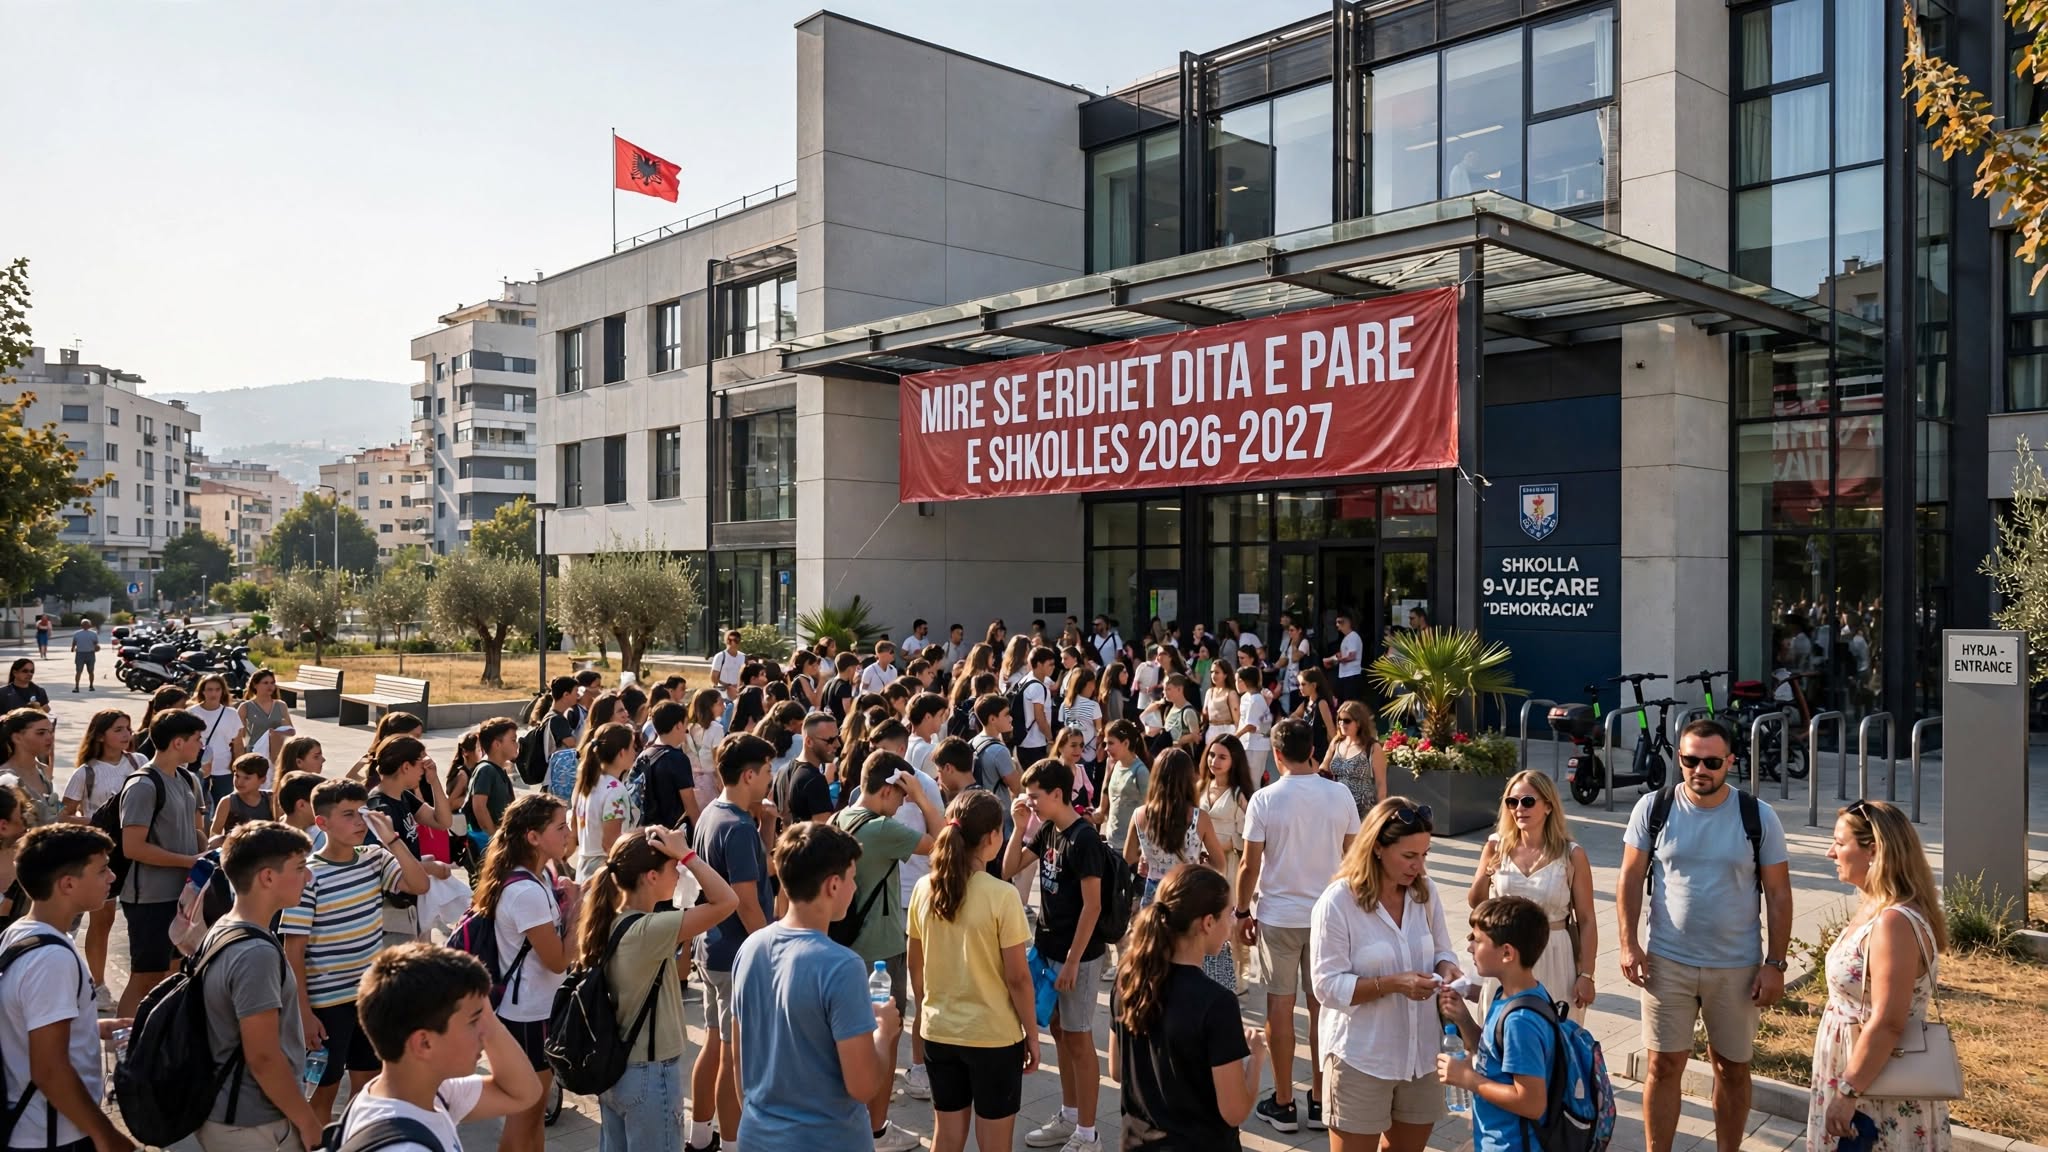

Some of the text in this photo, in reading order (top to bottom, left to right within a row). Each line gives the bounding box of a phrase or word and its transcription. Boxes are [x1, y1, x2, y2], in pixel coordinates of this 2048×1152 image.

[921, 315, 1415, 434] MIRE SE ERDHET DITA E PARE
[967, 402, 1333, 484] E SHKOLLES 2026-2027
[1502, 557, 1579, 572] SHKOLLA
[1482, 577, 1599, 600] 9-VJEÇARE
[1962, 644, 1997, 656] HYRJA
[1954, 660, 2012, 673] ENTRANCE
